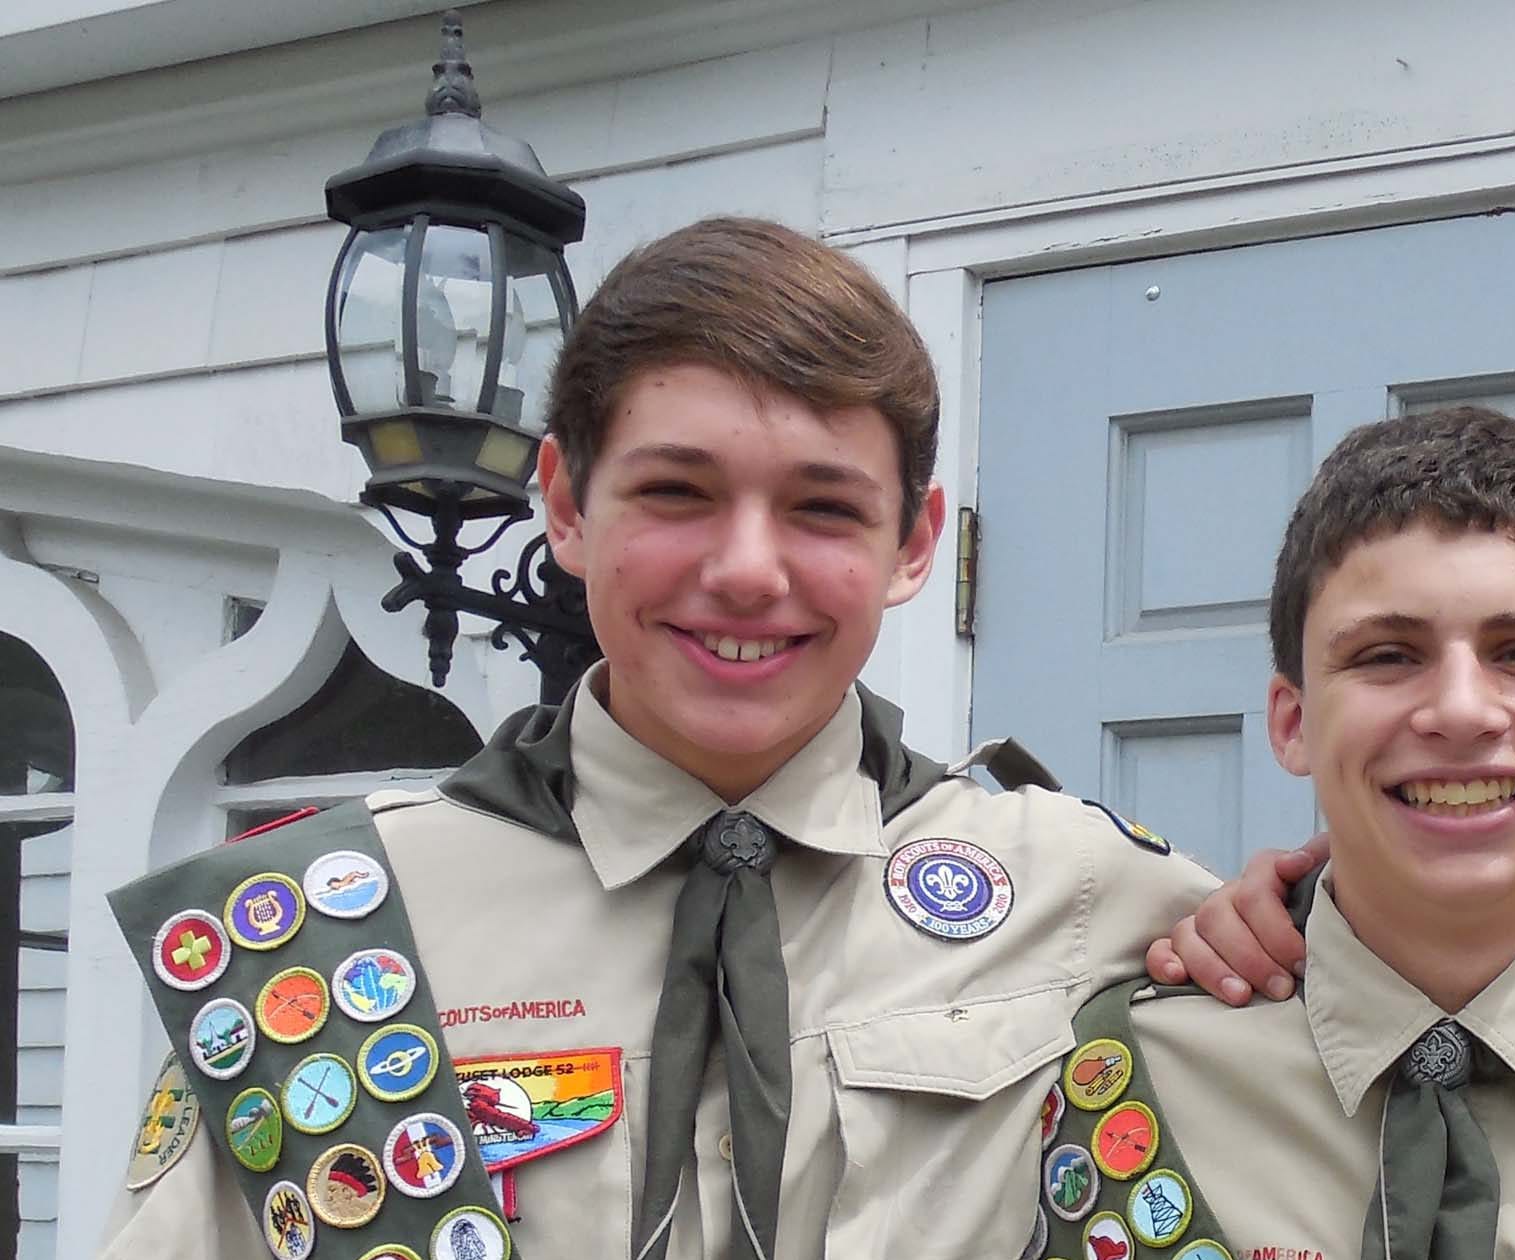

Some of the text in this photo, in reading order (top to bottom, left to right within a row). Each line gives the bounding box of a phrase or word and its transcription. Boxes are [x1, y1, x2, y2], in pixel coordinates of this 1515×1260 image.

[953, 843, 1003, 880] AMERICA
[929, 918, 990, 935] 100 YEARS
[502, 1064, 553, 1079] LODGE
[556, 1063, 574, 1075] 52
[159, 1106, 193, 1165] LEADER
